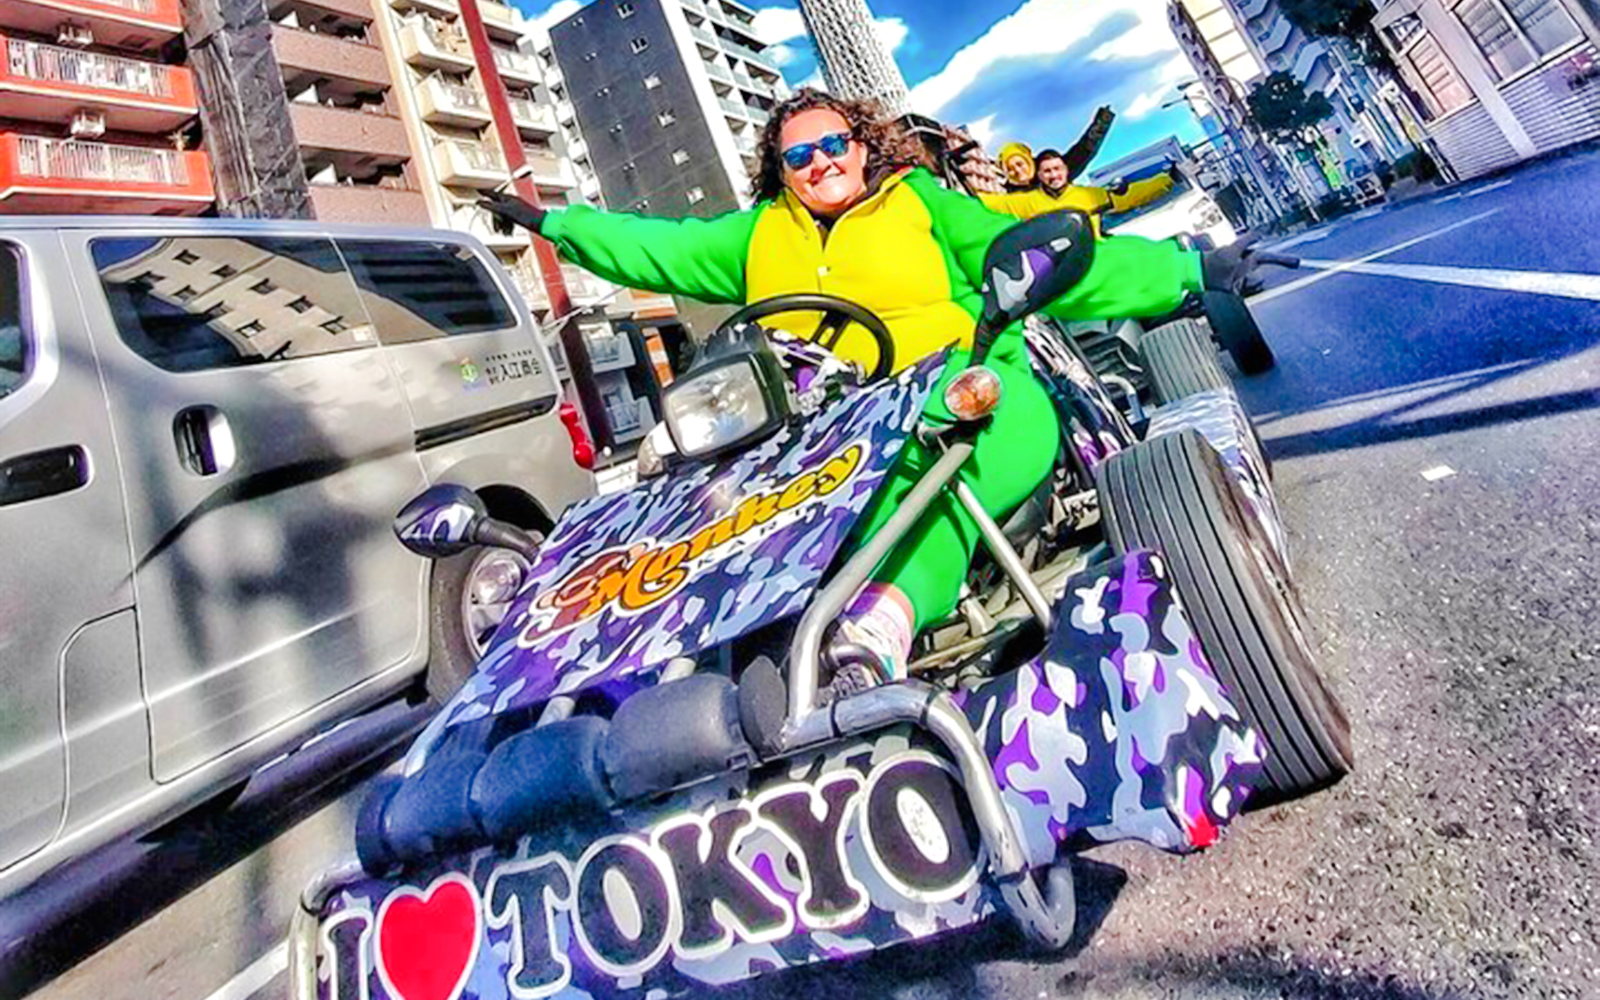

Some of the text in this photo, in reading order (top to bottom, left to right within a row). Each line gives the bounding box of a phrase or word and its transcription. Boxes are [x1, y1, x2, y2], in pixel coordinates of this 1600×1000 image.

[572, 443, 865, 624] Monkey
[324, 755, 985, 1000] I TOKYO
